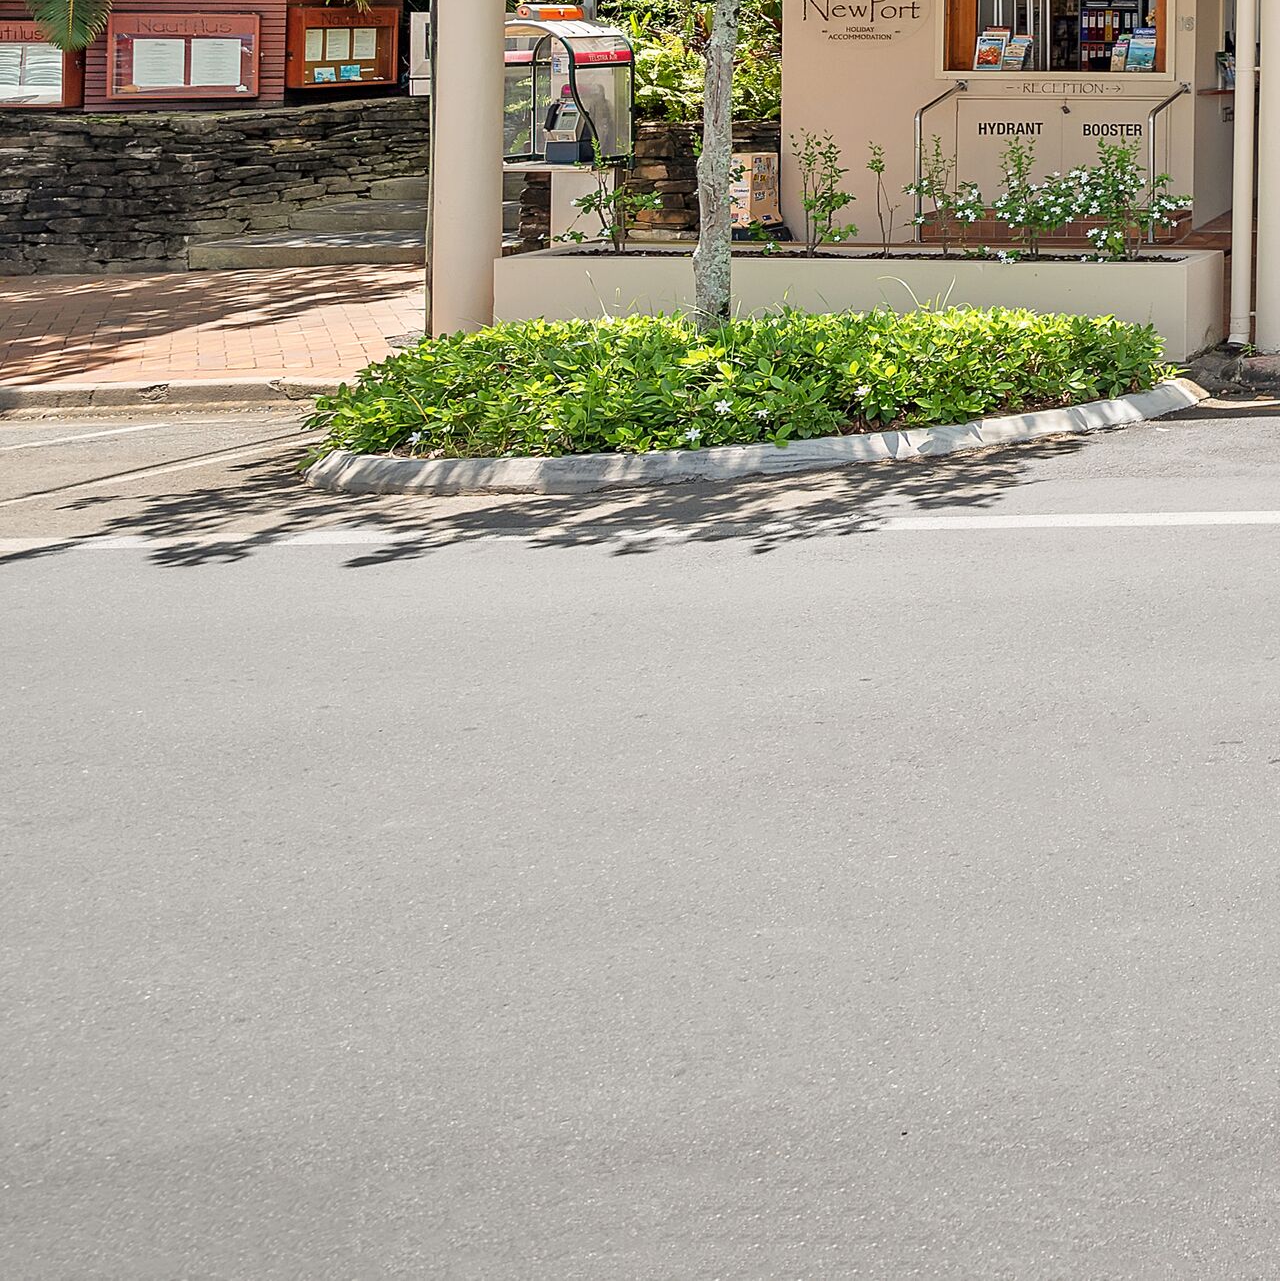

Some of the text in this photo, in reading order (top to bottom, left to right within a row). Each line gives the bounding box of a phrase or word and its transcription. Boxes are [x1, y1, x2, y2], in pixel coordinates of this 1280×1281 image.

[136, 18, 233, 33] Nautilus
[0, 26, 44, 40] tilus
[827, 33, 892, 41] ACCOMMODATION
[588, 54, 609, 62] TELSTRA
[1022, 82, 1105, 94] RECEPTION
[978, 122, 1044, 135] HYDRANT
[1082, 123, 1143, 136] BOOSTER
